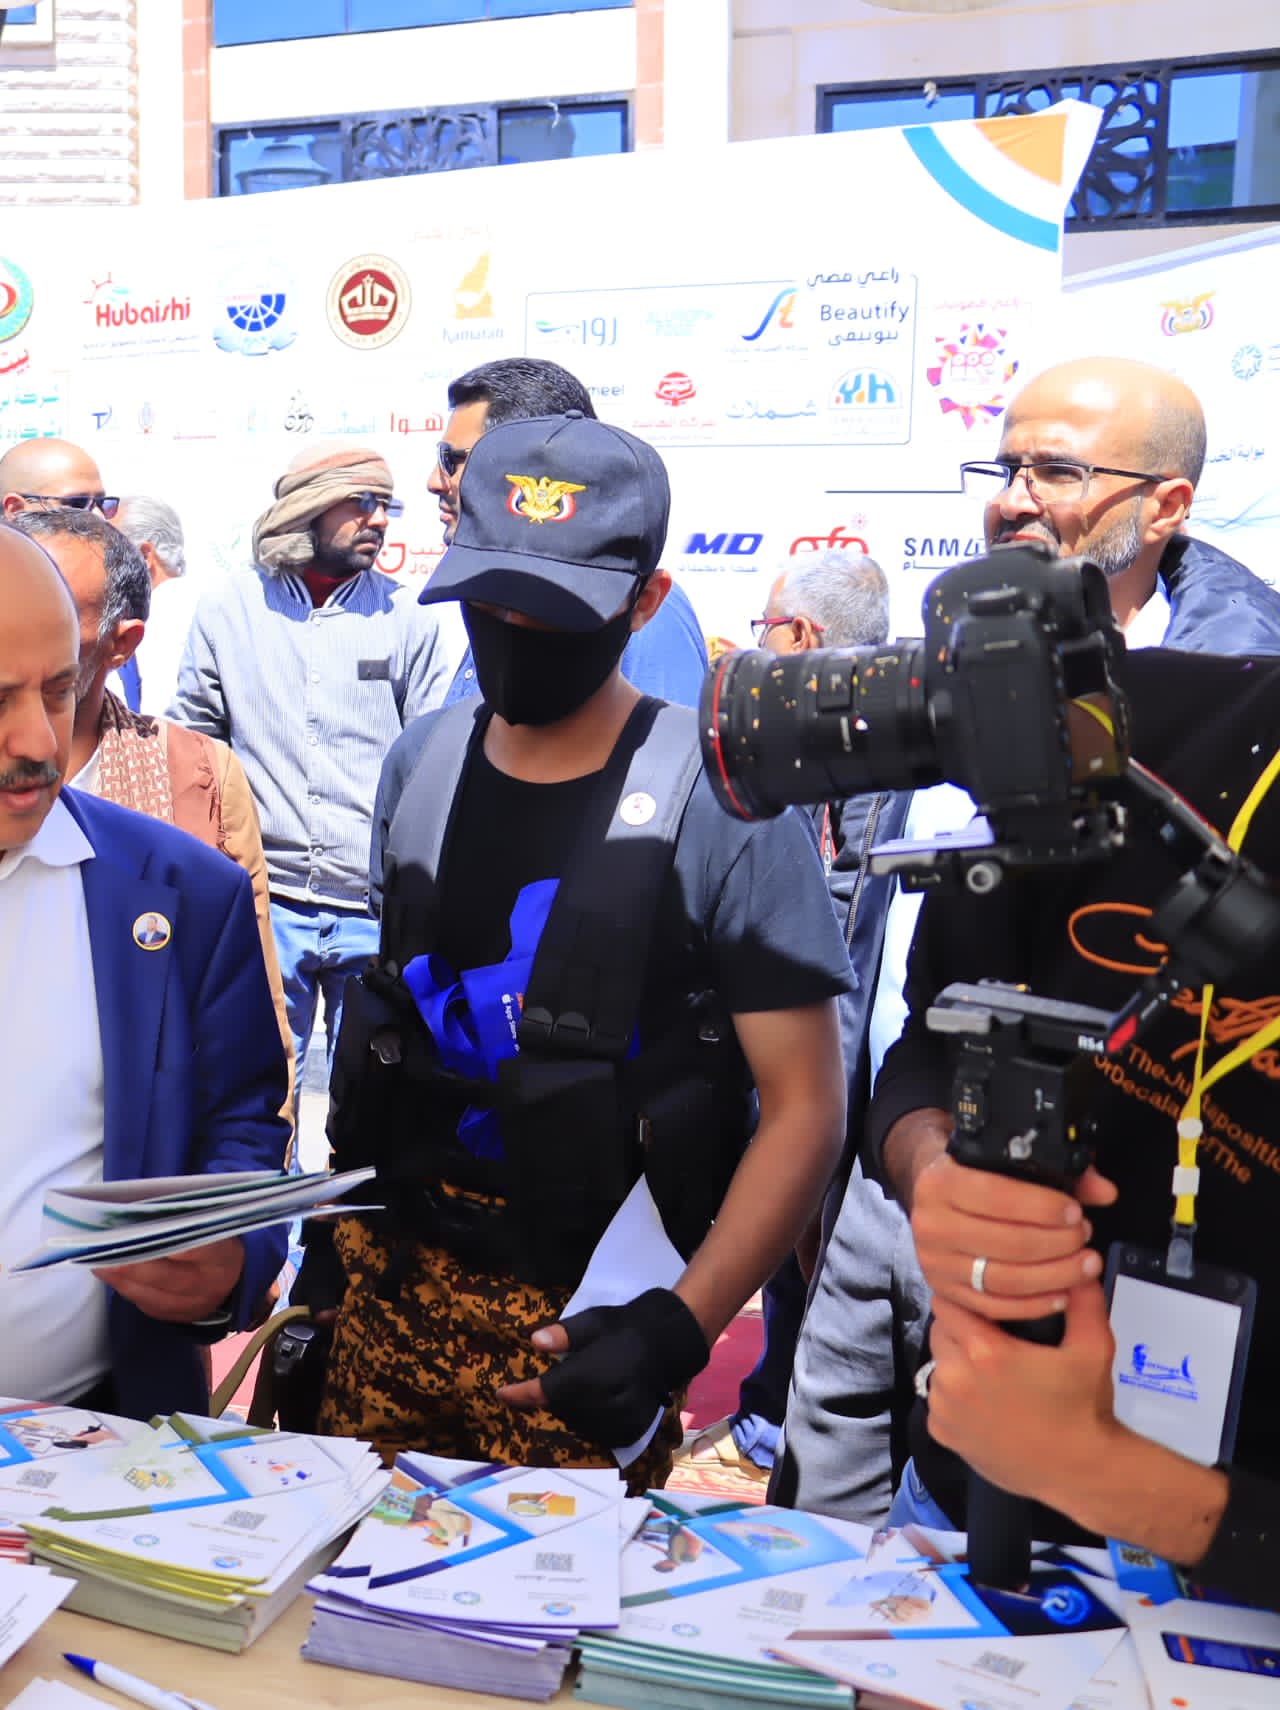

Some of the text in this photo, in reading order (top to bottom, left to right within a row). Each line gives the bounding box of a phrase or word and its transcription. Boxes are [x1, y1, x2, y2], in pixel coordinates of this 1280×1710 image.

[96, 296, 191, 328] Hubaishi
[820, 300, 910, 323] Beautify
[685, 532, 765, 555] MD
